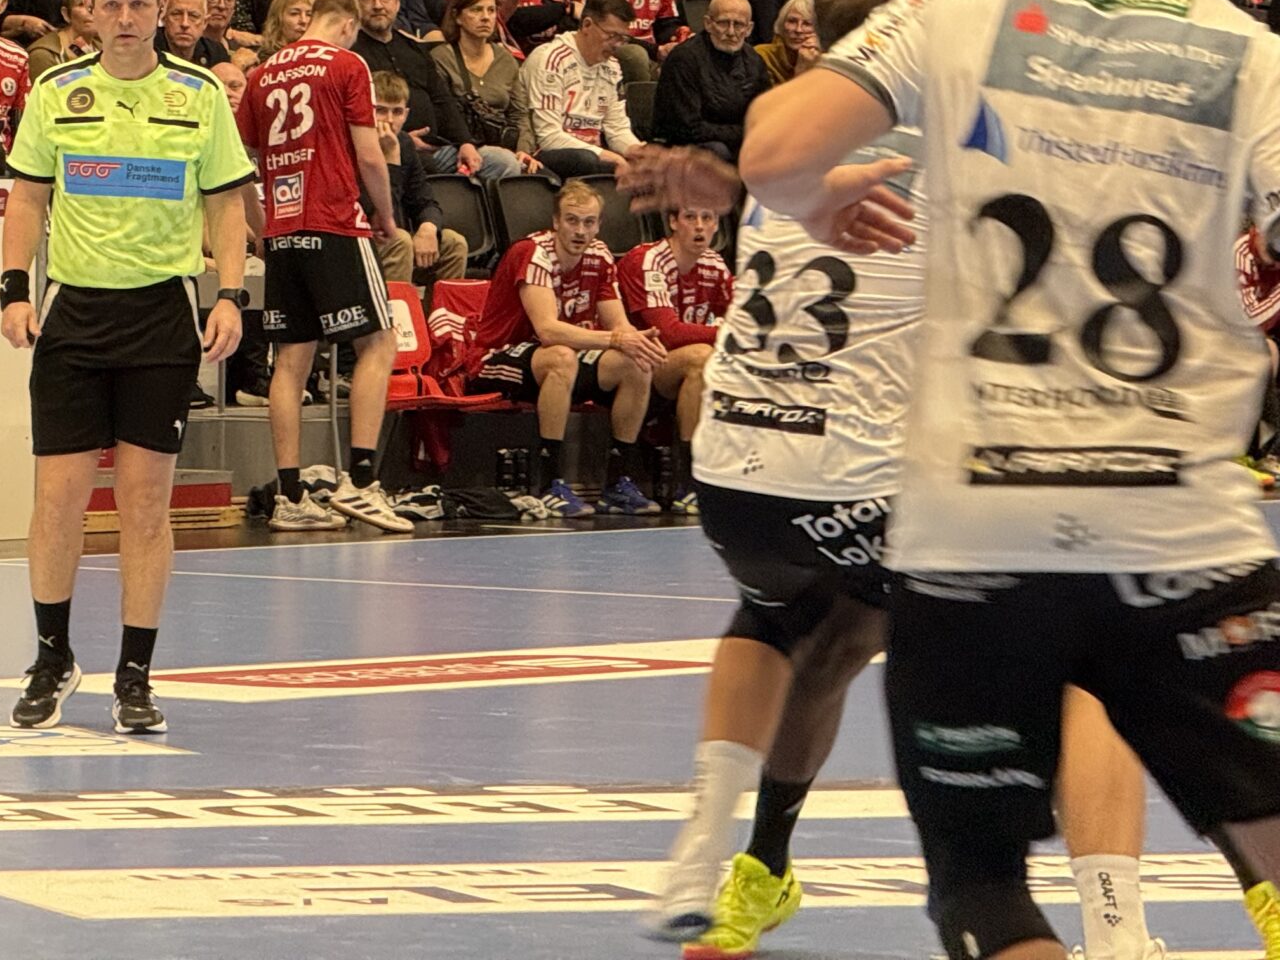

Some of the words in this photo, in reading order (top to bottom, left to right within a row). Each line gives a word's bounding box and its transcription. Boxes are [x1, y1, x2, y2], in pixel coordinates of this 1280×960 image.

[265, 82, 315, 147] 23
[126, 162, 162, 173] Danske
[126, 173, 180, 184] Fragtmænd
[722, 250, 857, 365] 33
[969, 193, 1182, 381] 28
